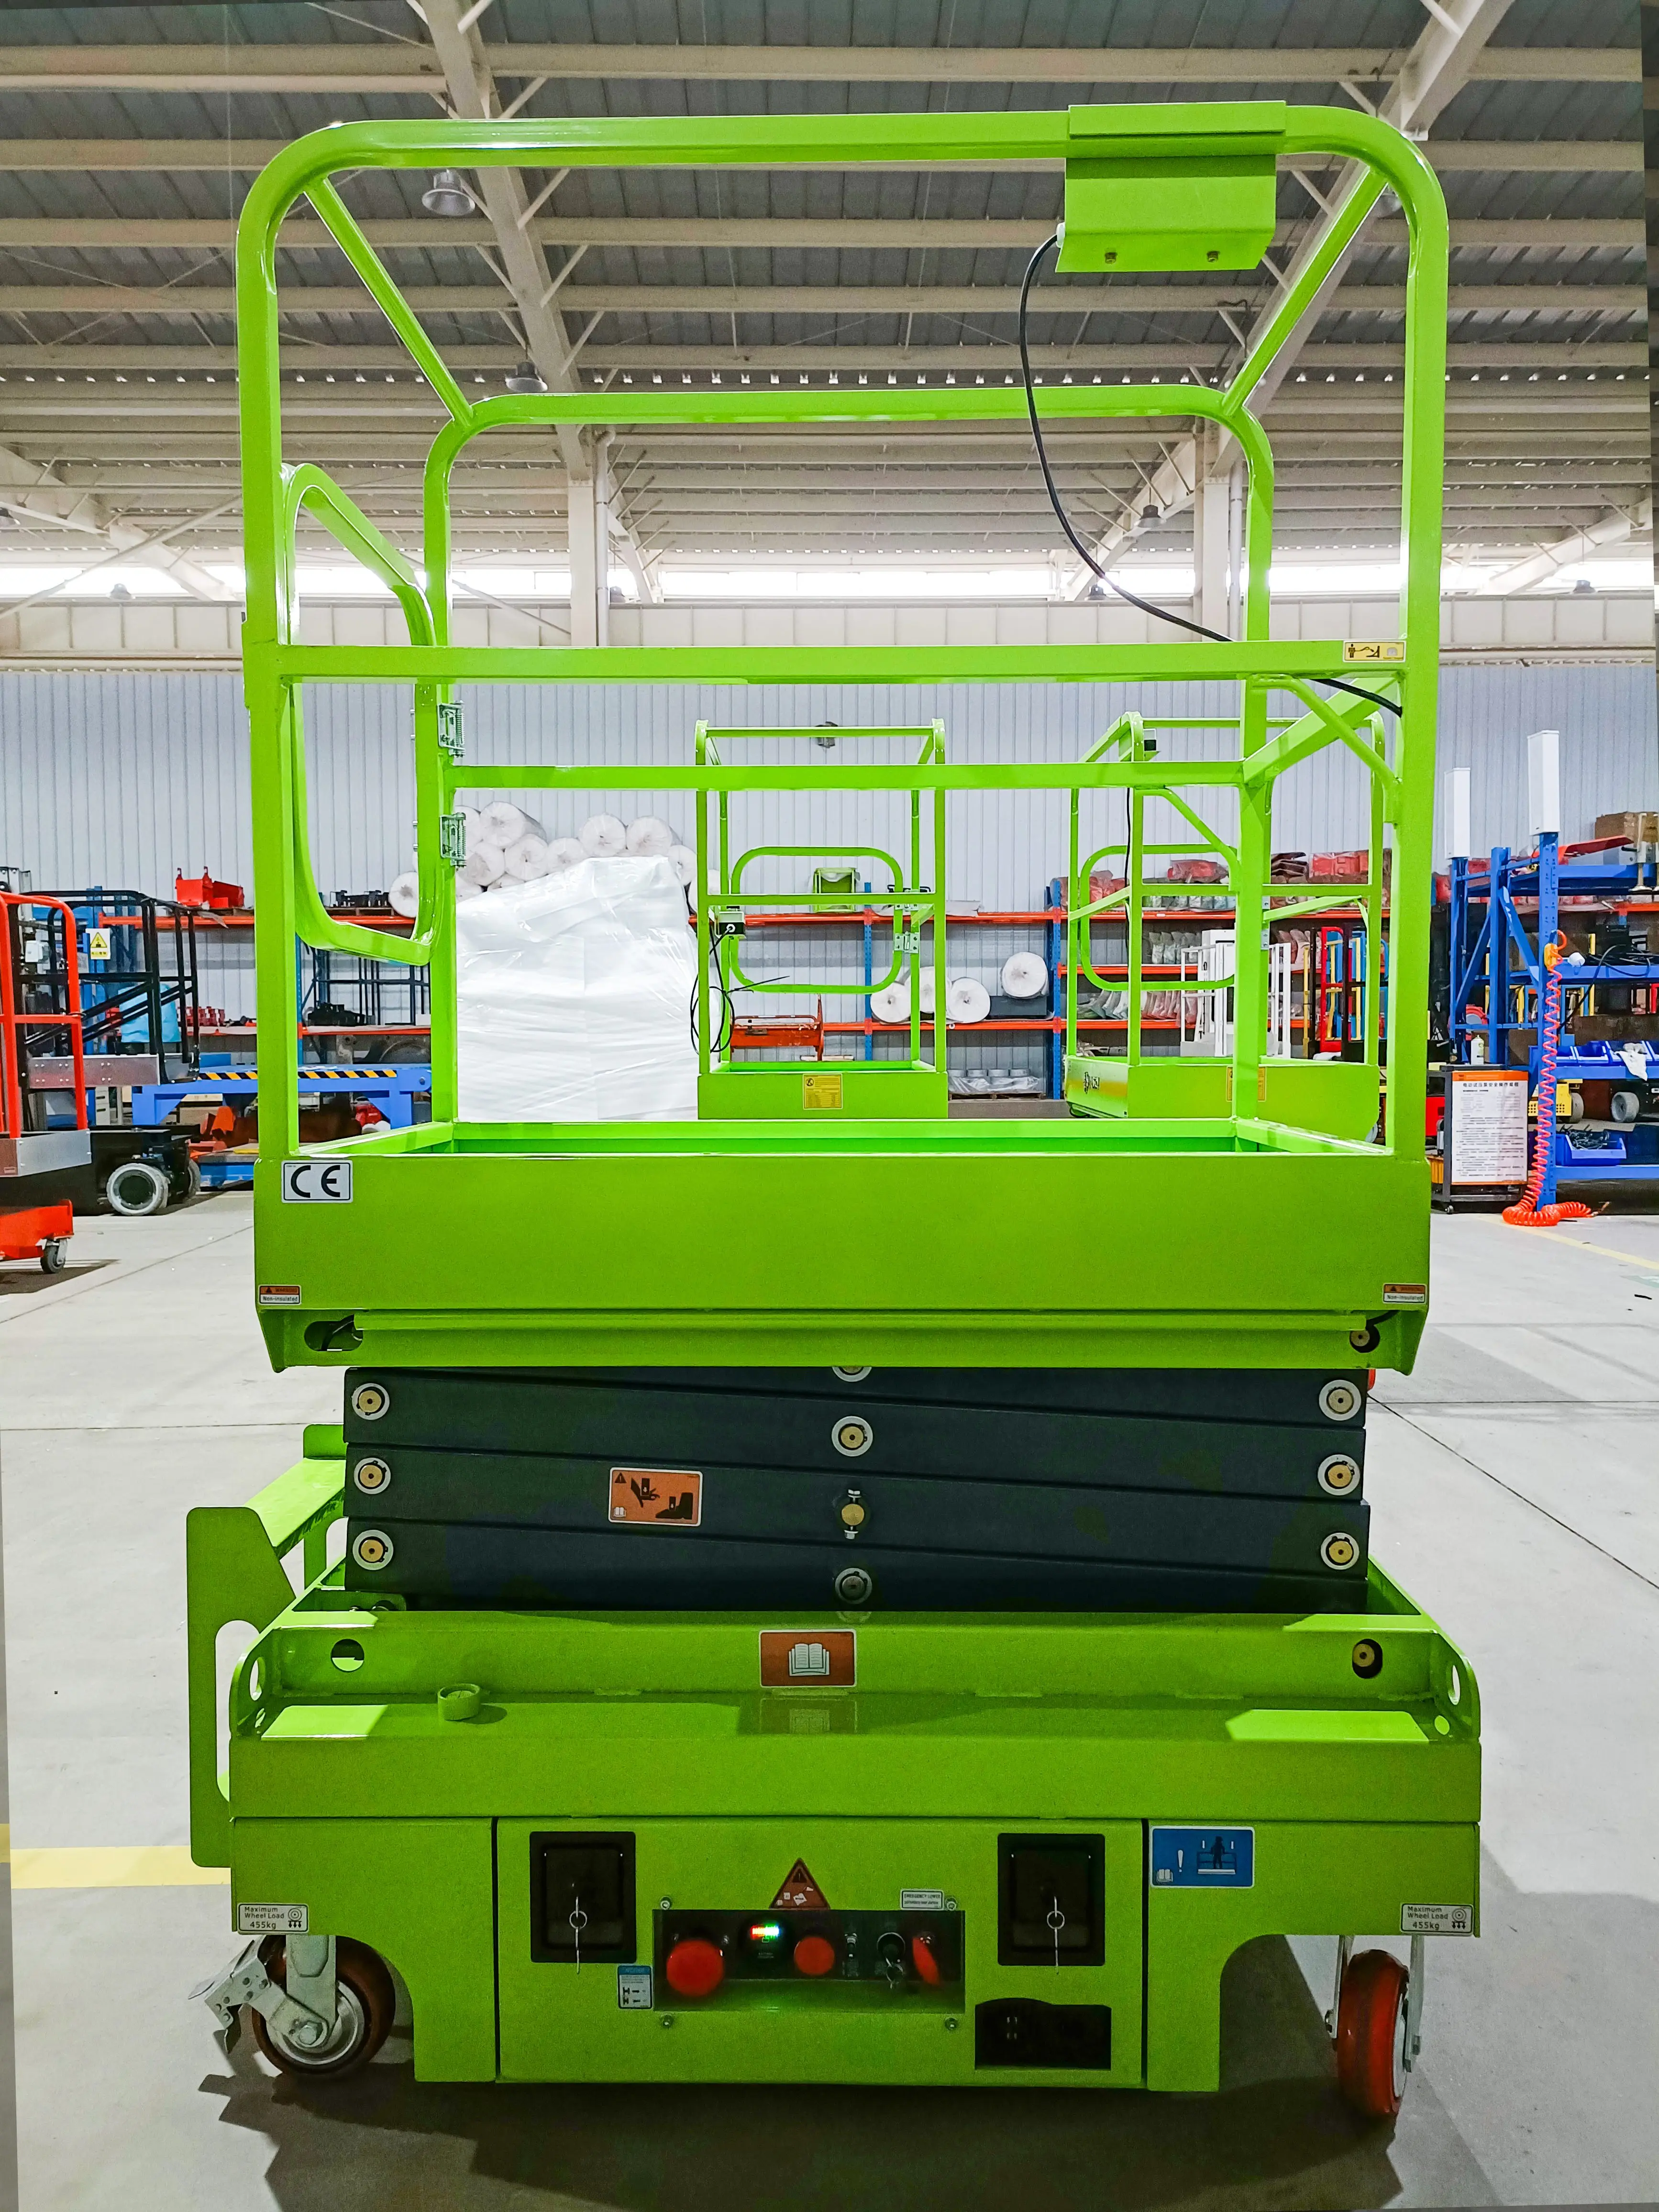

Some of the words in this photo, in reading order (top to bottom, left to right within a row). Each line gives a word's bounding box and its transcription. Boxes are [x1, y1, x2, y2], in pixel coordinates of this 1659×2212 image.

[291, 1165, 341, 1198] CE
[250, 1921, 276, 1930] 455kg
[1412, 1922, 1440, 1930] 455kg
